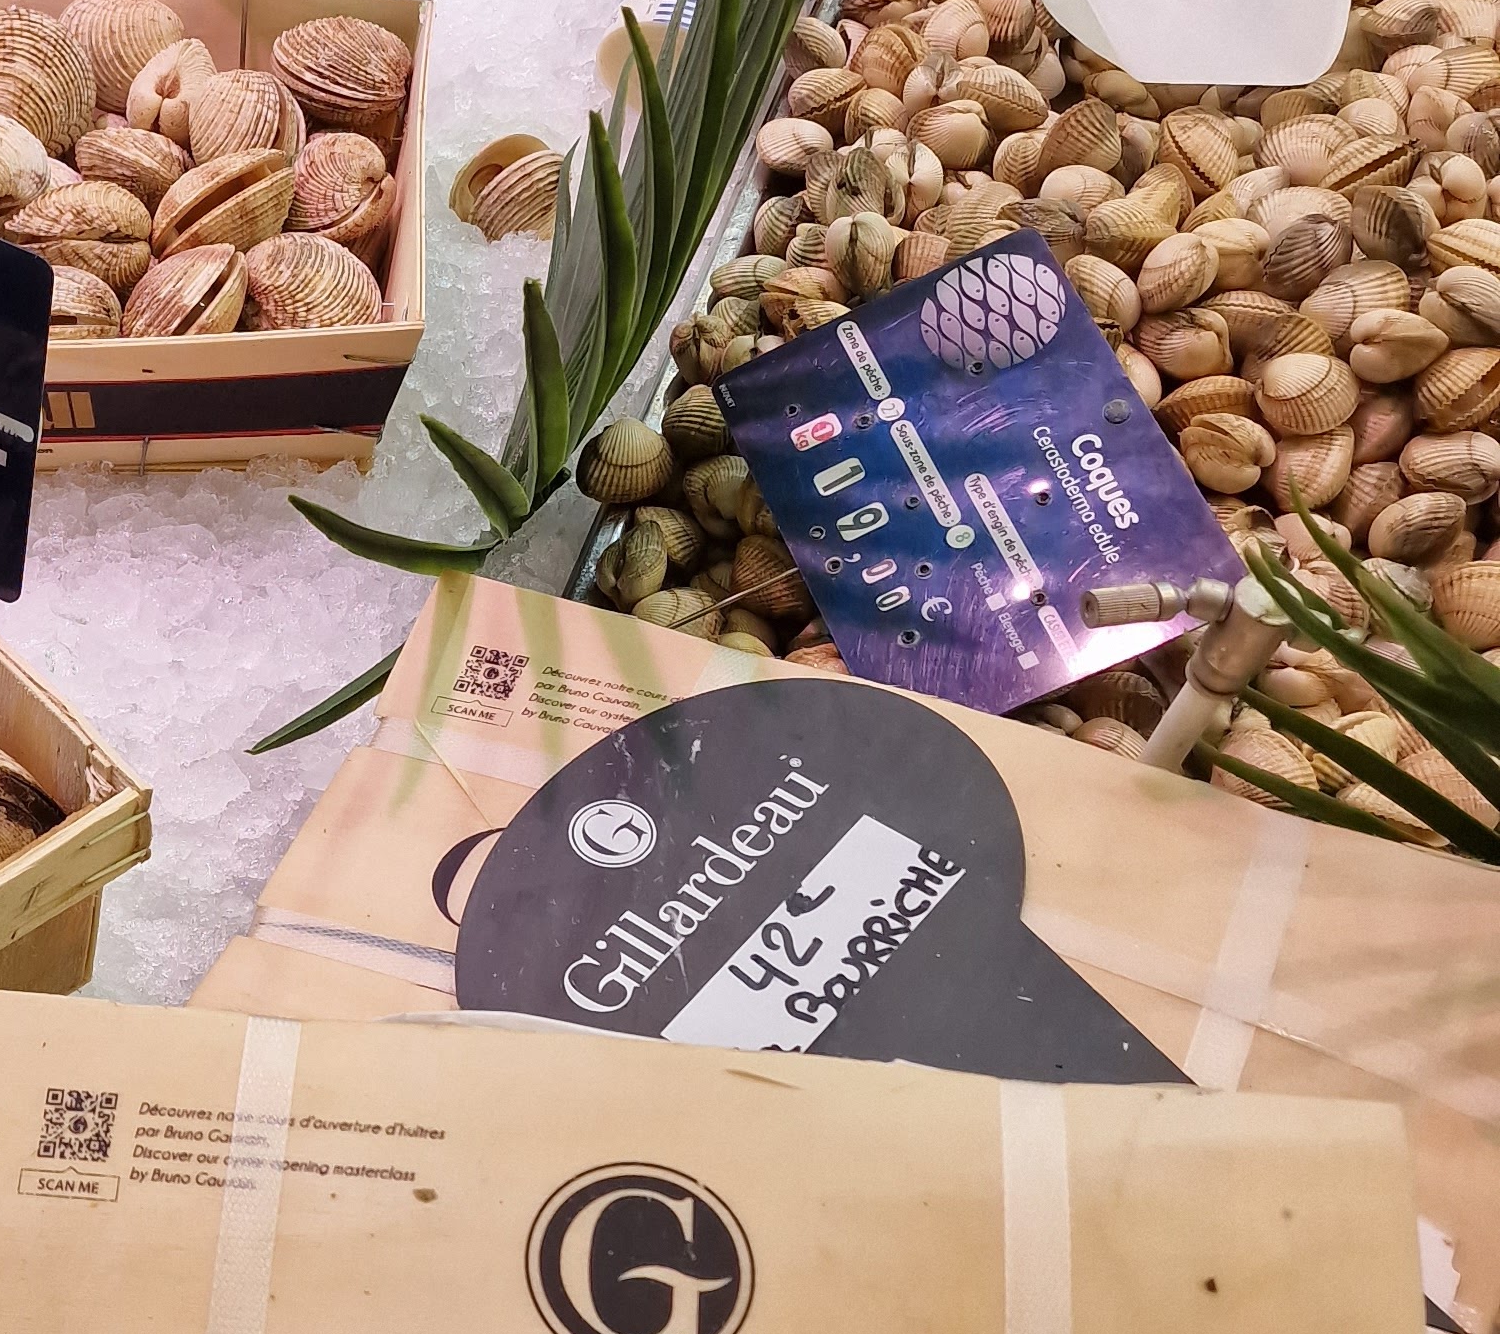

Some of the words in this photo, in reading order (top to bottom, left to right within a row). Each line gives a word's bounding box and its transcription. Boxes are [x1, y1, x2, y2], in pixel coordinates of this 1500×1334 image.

[841, 324, 860, 350] Zone
[854, 348, 867, 364] de
[794, 428, 811, 449] kg
[895, 423, 928, 475] Sous-zone
[921, 472, 936, 490] de
[1033, 425, 1096, 524] Cerastoderma
[1087, 522, 1121, 564] edule
[1071, 433, 1140, 530] Coques
[968, 475, 987, 502] Type
[983, 497, 1009, 542] d'engin
[1002, 536, 1018, 554] de
[920, 595, 953, 622] €
[970, 561, 995, 596] Pêche
[998, 612, 1026, 654] Elevage
[533, 680, 555, 693] par
[557, 684, 590, 699] Bruno
[541, 666, 602, 687] Découvrez
[604, 678, 635, 693] notre
[636, 687, 668, 703] cours
[447, 704, 477, 717] SCAN
[477, 710, 497, 722] ME
[520, 706, 537, 719] by
[537, 710, 571, 725] Bruno
[528, 692, 577, 710] Discover
[579, 703, 599, 715] our
[562, 765, 830, 1014] Gillardeau
[134, 1126, 161, 1140] par
[162, 1125, 204, 1142] Bruno
[137, 1101, 213, 1122] Découvrez
[299, 1116, 381, 1136] d'ouverture
[384, 1120, 446, 1141] d'huîtres
[129, 1167, 149, 1185] by
[151, 1168, 191, 1186] Bruno
[131, 1144, 193, 1163] Discover
[196, 1152, 220, 1165] our
[331, 1162, 416, 1183] masterclass
[37, 1178, 76, 1193] SCAN
[77, 1180, 100, 1195] ME
